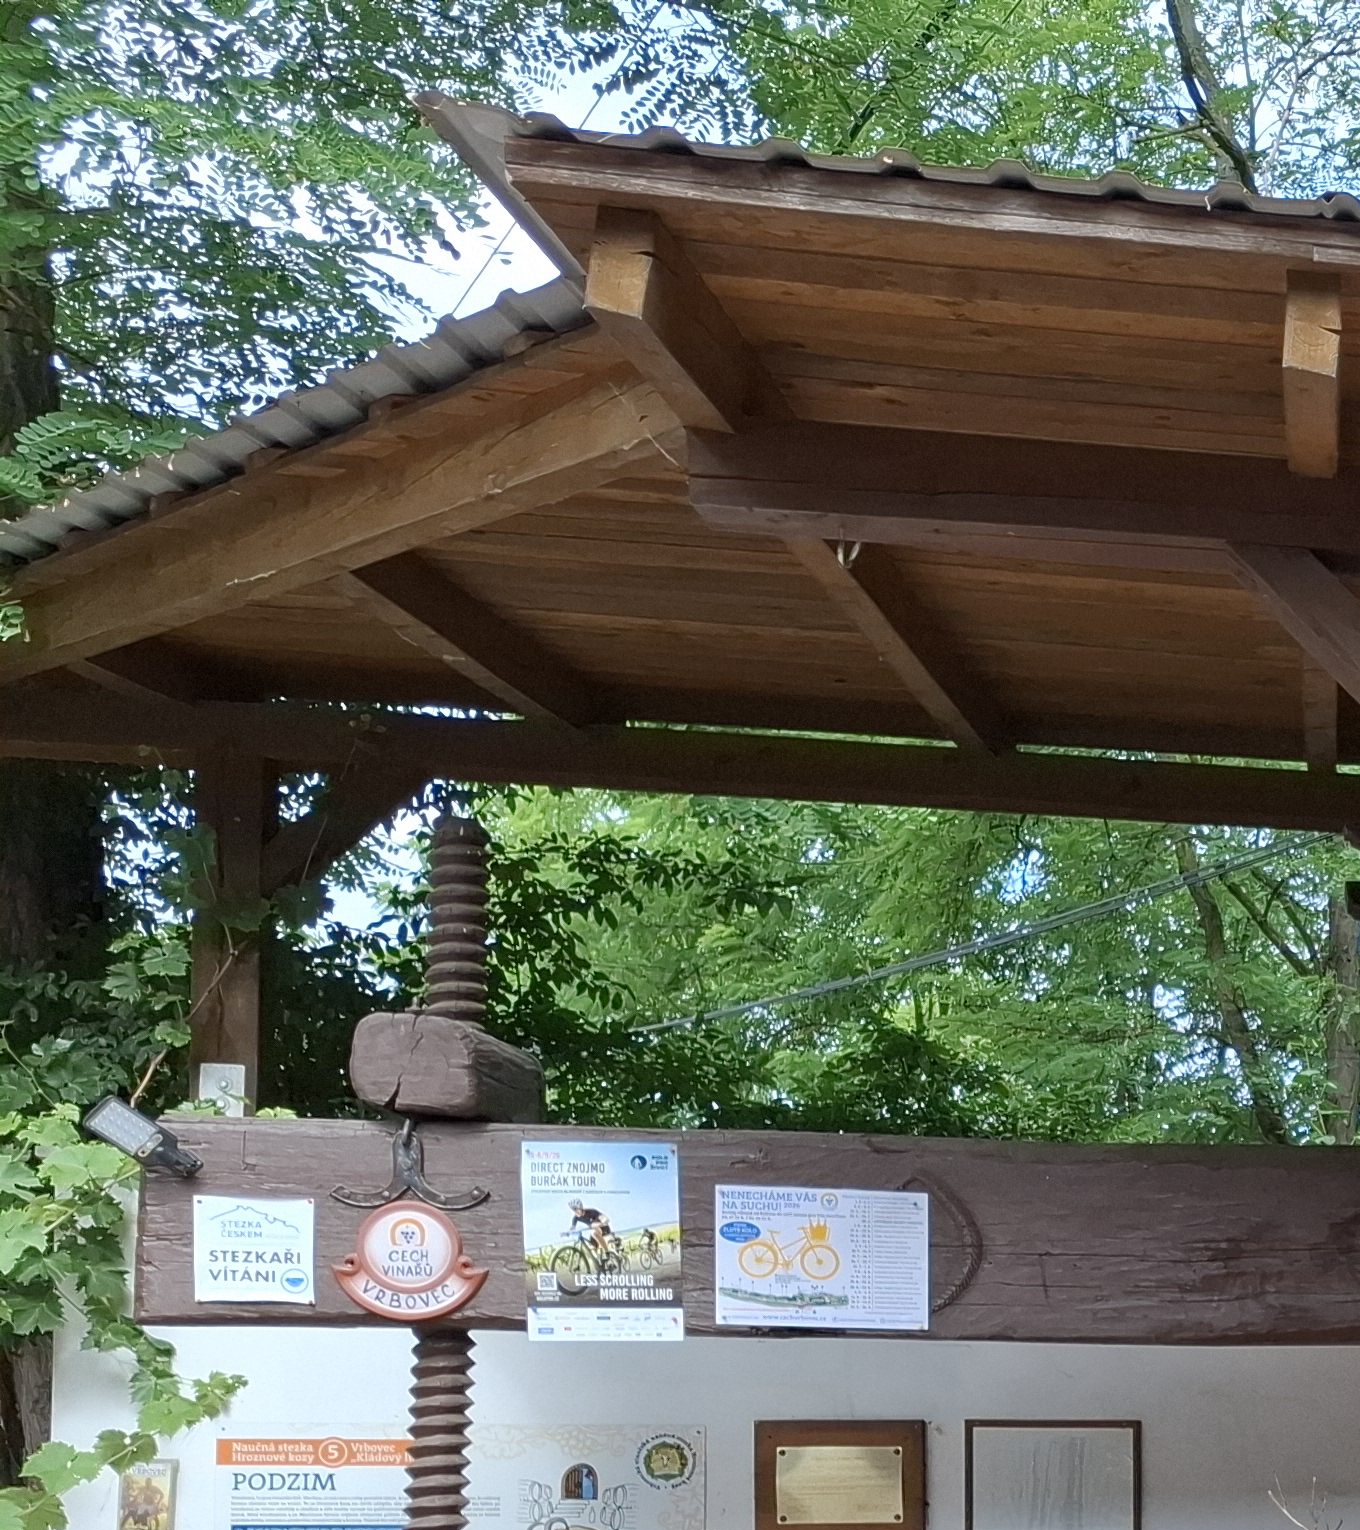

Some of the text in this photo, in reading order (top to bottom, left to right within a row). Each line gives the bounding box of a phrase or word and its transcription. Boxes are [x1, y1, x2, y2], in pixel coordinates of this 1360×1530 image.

[530, 1161, 606, 1174] DIRECT ZNOJMO
[530, 1174, 597, 1188] BURČÁK TOUR
[721, 1190, 818, 1203] NENECHÁME VÁS
[721, 1200, 739, 1210] NA
[740, 1201, 782, 1212] SUCHU!
[220, 1220, 262, 1229] STEZKA
[220, 1229, 263, 1238] ČESKEM
[208, 1247, 301, 1265] STEZKAŘI
[387, 1249, 429, 1264] CECH
[207, 1265, 276, 1283] VÍTÁNI
[381, 1262, 433, 1278] VINAŘŮ
[574, 1273, 654, 1287] LESS SCROLLING
[361, 1278, 456, 1311] VRBOVEC
[599, 1288, 674, 1301] MORE ROLLING
[231, 1441, 314, 1452] Naučná stezka
[327, 1444, 339, 1459] 5
[350, 1442, 396, 1453] Vrbovec
[231, 1451, 315, 1464] Hroznové kozy
[231, 1472, 337, 1491] PODZIM
